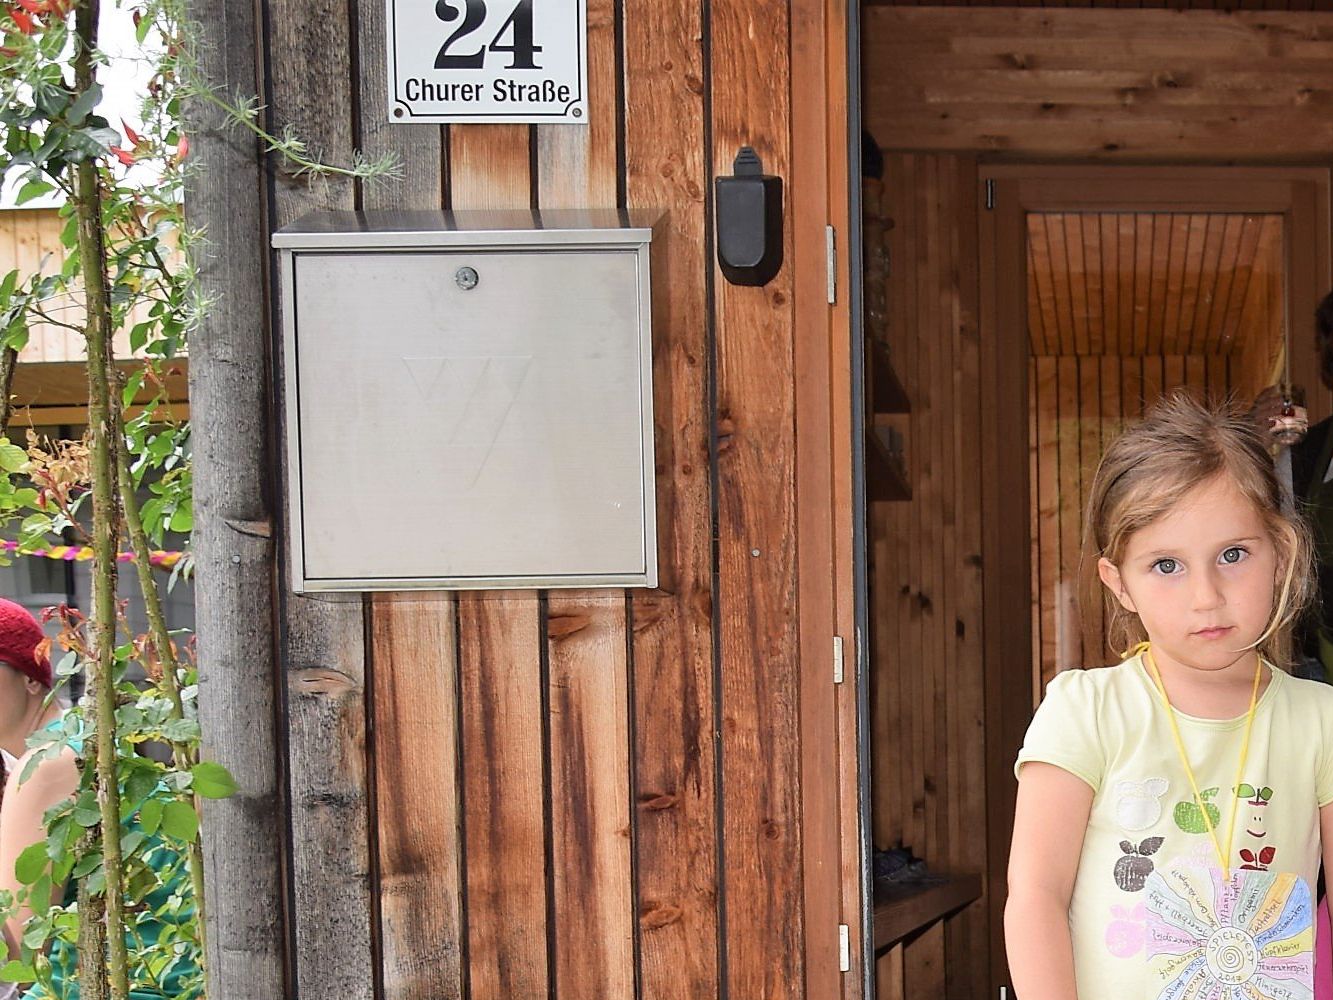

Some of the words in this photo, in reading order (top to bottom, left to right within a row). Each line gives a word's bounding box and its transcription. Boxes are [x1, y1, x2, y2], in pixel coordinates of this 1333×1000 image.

[434, 0, 543, 69] 24
[405, 78, 483, 102] Churer
[493, 78, 570, 103] Straße
[1238, 889, 1259, 924] Origami
[1210, 931, 1254, 966] SPIELEFEST
[1218, 973, 1242, 982] 2017
[1256, 976, 1292, 1000] Minigolf
